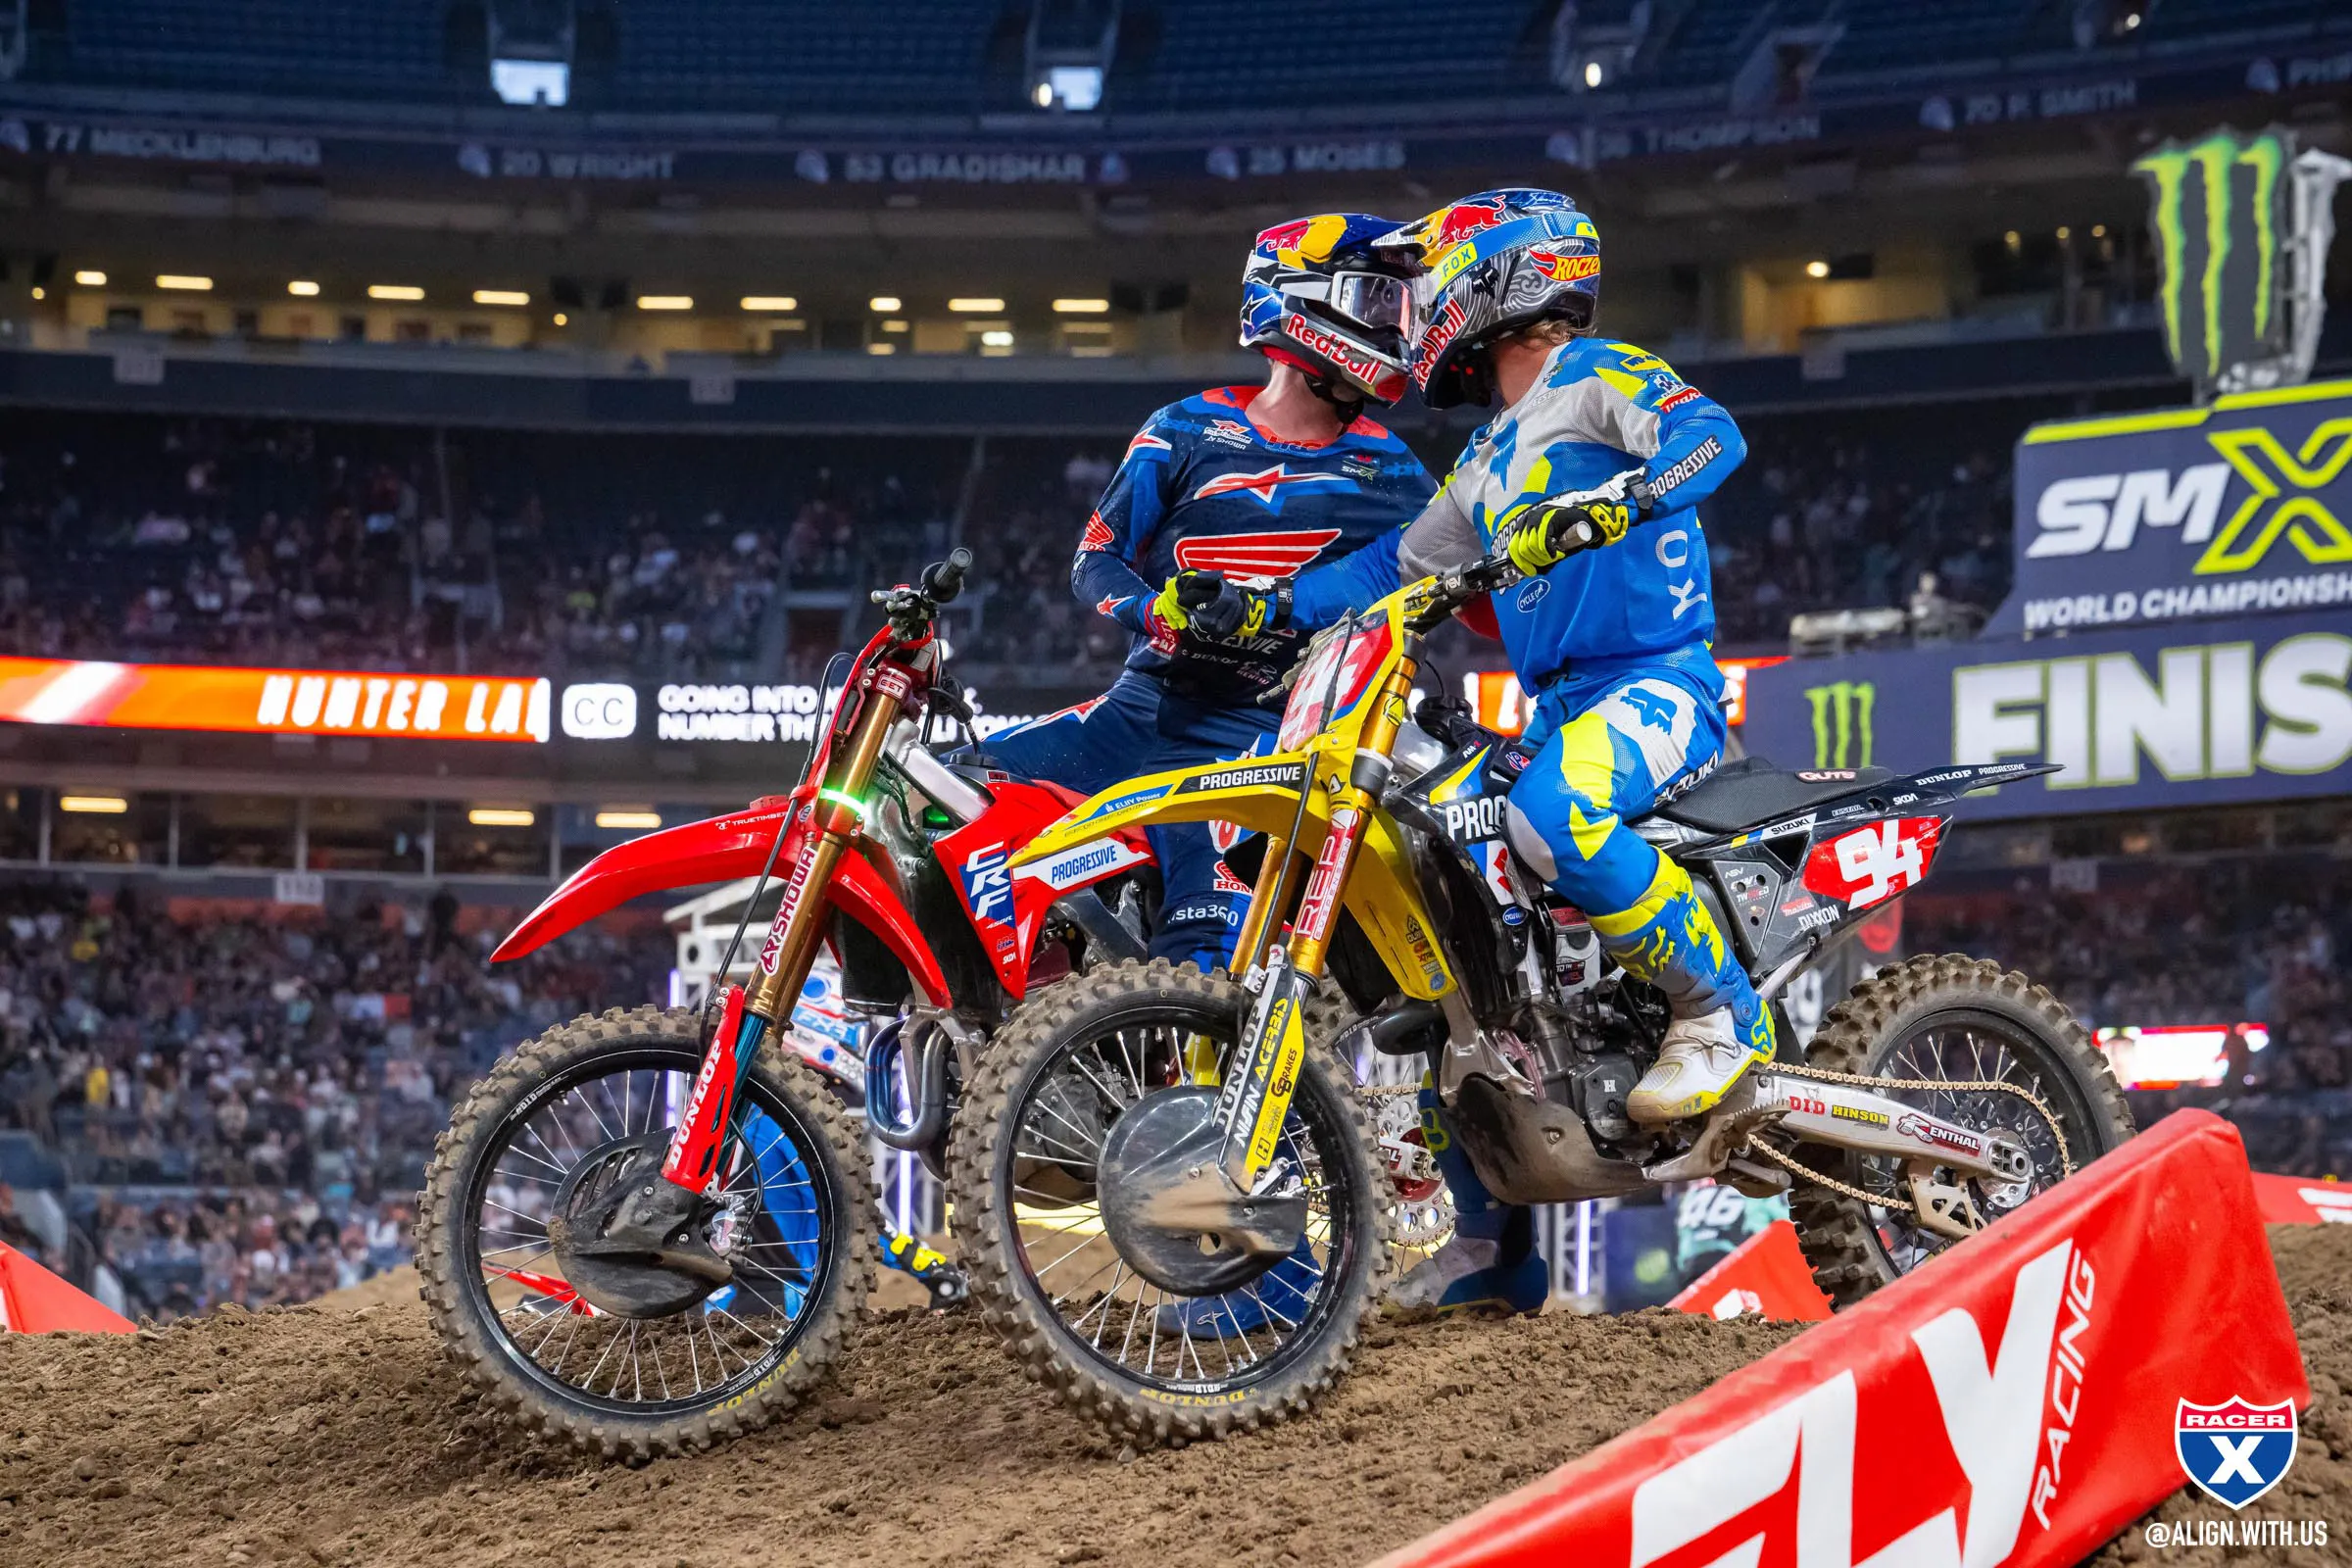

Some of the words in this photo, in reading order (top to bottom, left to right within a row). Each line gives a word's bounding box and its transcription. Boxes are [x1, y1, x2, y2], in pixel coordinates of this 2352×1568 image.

[1441, 246, 1473, 278] FOX
[1285, 313, 1335, 359] Red
[1329, 340, 1384, 386] Bull
[1412, 324, 1443, 392] Red
[1428, 297, 1468, 353] Bull
[1648, 435, 1723, 501] ROGRESSIVE
[2025, 599, 2134, 630] WORLD
[258, 674, 448, 730] HUNTER
[658, 685, 749, 714] GOING
[658, 713, 775, 742] NUMBER
[1199, 765, 1301, 791] PROGRESSIVE
[1798, 770, 1857, 782] GUTS
[1915, 769, 1973, 786] DUNLOP
[1978, 762, 2028, 775] PROGRESSIVE
[1771, 817, 1811, 835] SUZUKI
[965, 841, 1012, 921] CRF
[1051, 844, 1117, 884] PROGRESSIVE
[1724, 866, 1744, 879] ASV
[1834, 819, 1924, 911] 94
[770, 847, 817, 943] SHOWA
[1215, 880, 1255, 895] HON
[1296, 835, 1336, 936] REP
[1167, 904, 1239, 927] sta360
[1213, 1004, 1262, 1128] DUNLOP
[667, 1039, 723, 1169] DUNLOP
[1832, 1104, 1889, 1126] HINSON
[1898, 1114, 1981, 1151] RENTHAL
[1139, 1387, 1247, 1407] DUNLOP
[1632, 1239, 2073, 1568] FLY
[2031, 1248, 2096, 1532] RACING
